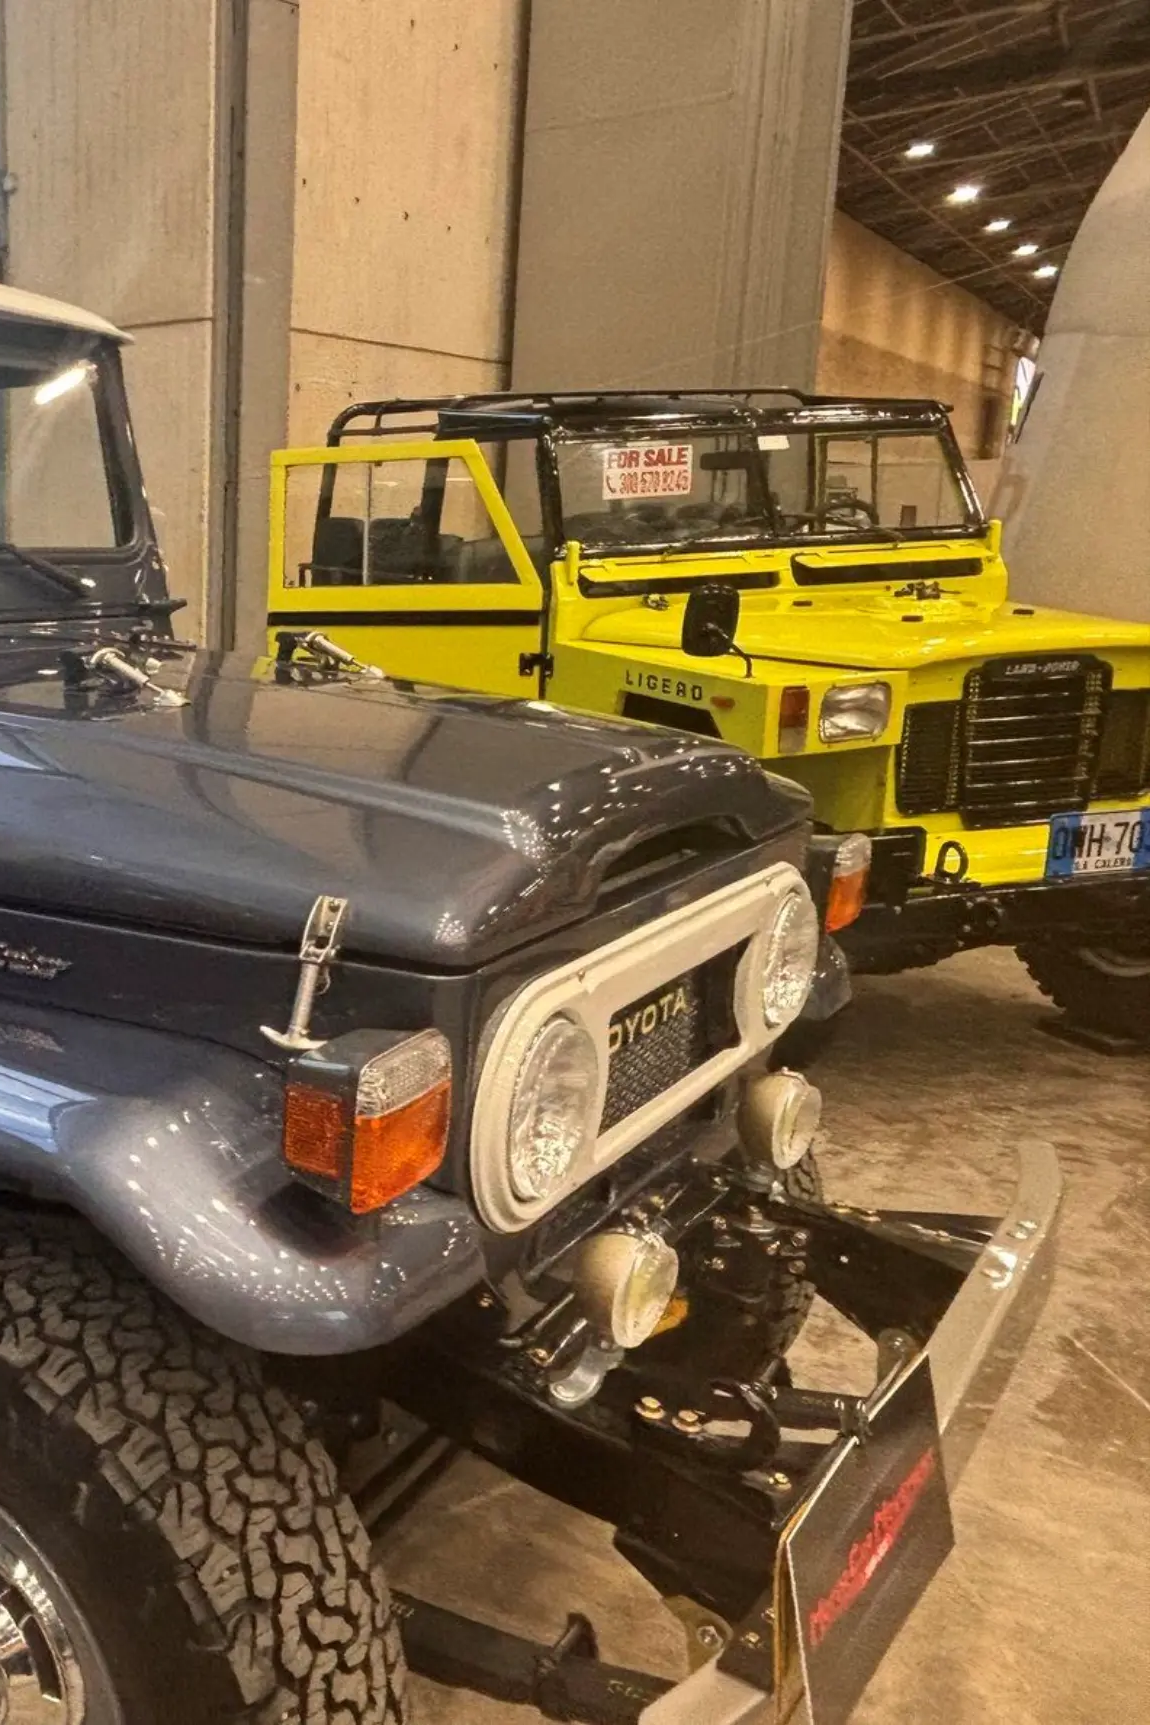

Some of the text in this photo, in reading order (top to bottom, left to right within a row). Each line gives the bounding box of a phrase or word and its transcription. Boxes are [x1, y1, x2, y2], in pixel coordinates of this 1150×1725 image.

[608, 447, 689, 469] FOR SALE
[625, 669, 703, 701] LIGERO
[607, 986, 688, 1054] OYOTA
